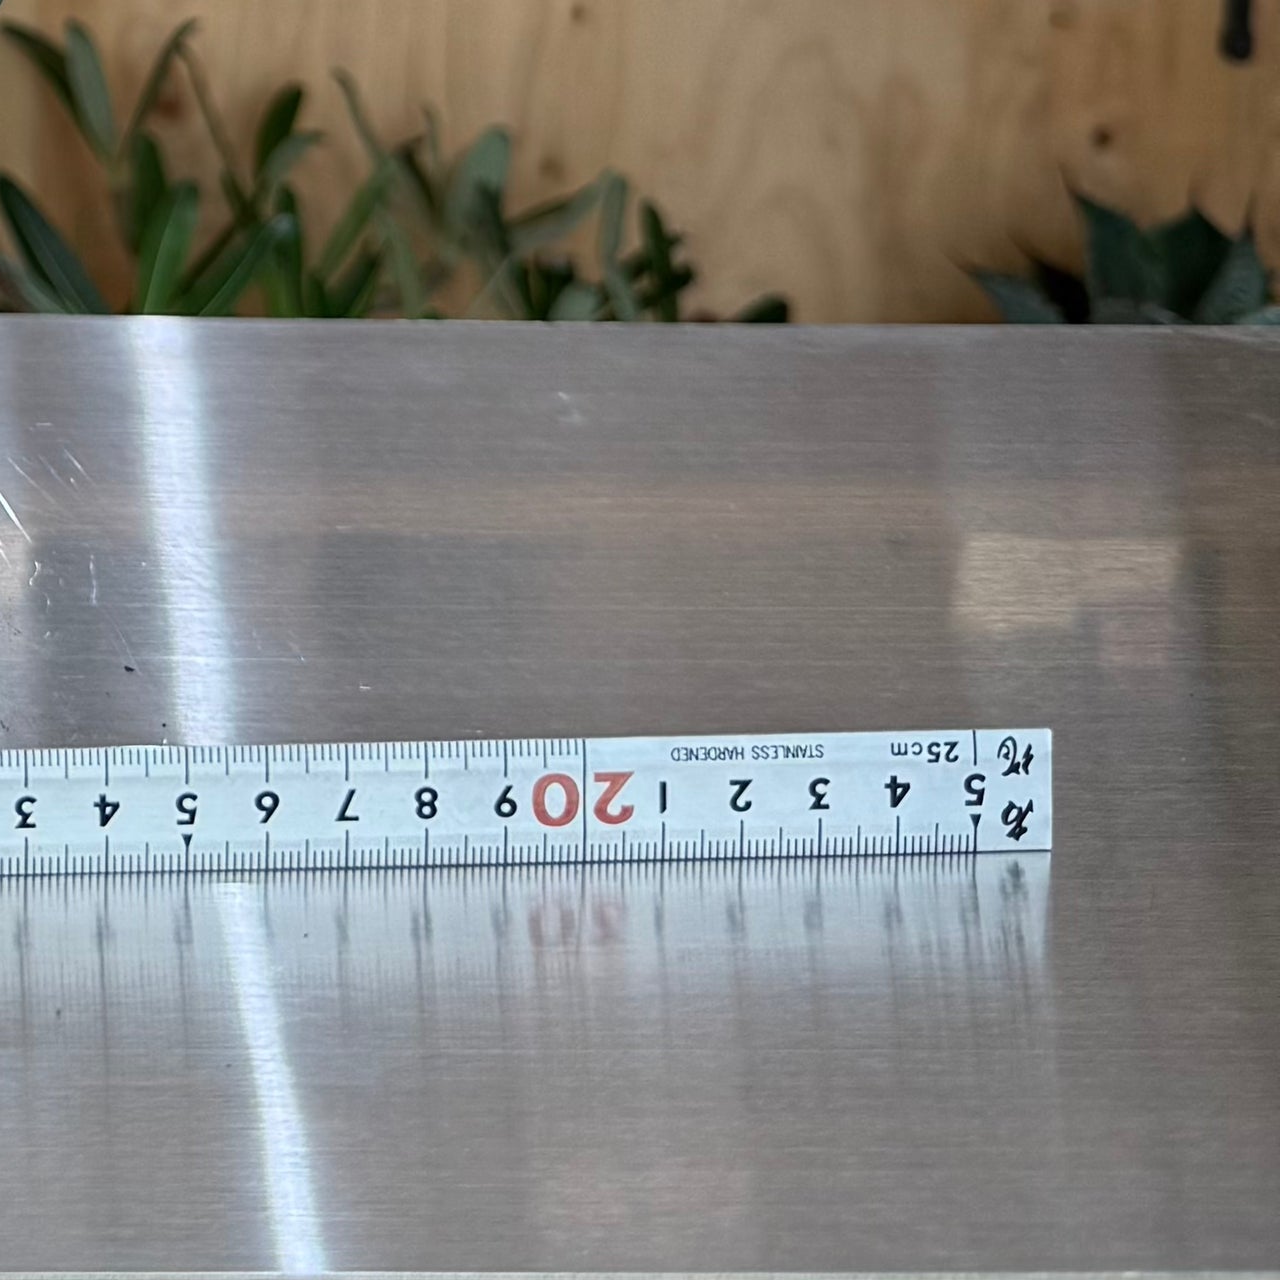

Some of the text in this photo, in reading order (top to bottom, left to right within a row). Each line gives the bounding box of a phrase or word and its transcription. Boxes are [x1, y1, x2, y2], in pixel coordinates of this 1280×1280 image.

[670, 743, 825, 762] STAINLESS HARDENED
[890, 741, 959, 764] 25cm
[15, 796, 37, 828] 3
[94, 794, 120, 827] 4
[176, 793, 198, 825] 5
[255, 791, 279, 823] 6
[336, 789, 359, 821] 7
[415, 787, 438, 819] 8
[494, 785, 517, 817] 9
[533, 773, 634, 827] 20
[659, 781, 668, 813] 1
[730, 779, 752, 812] 2
[809, 778, 830, 810] 3
[885, 776, 910, 808] 4
[964, 773, 986, 806] 5
